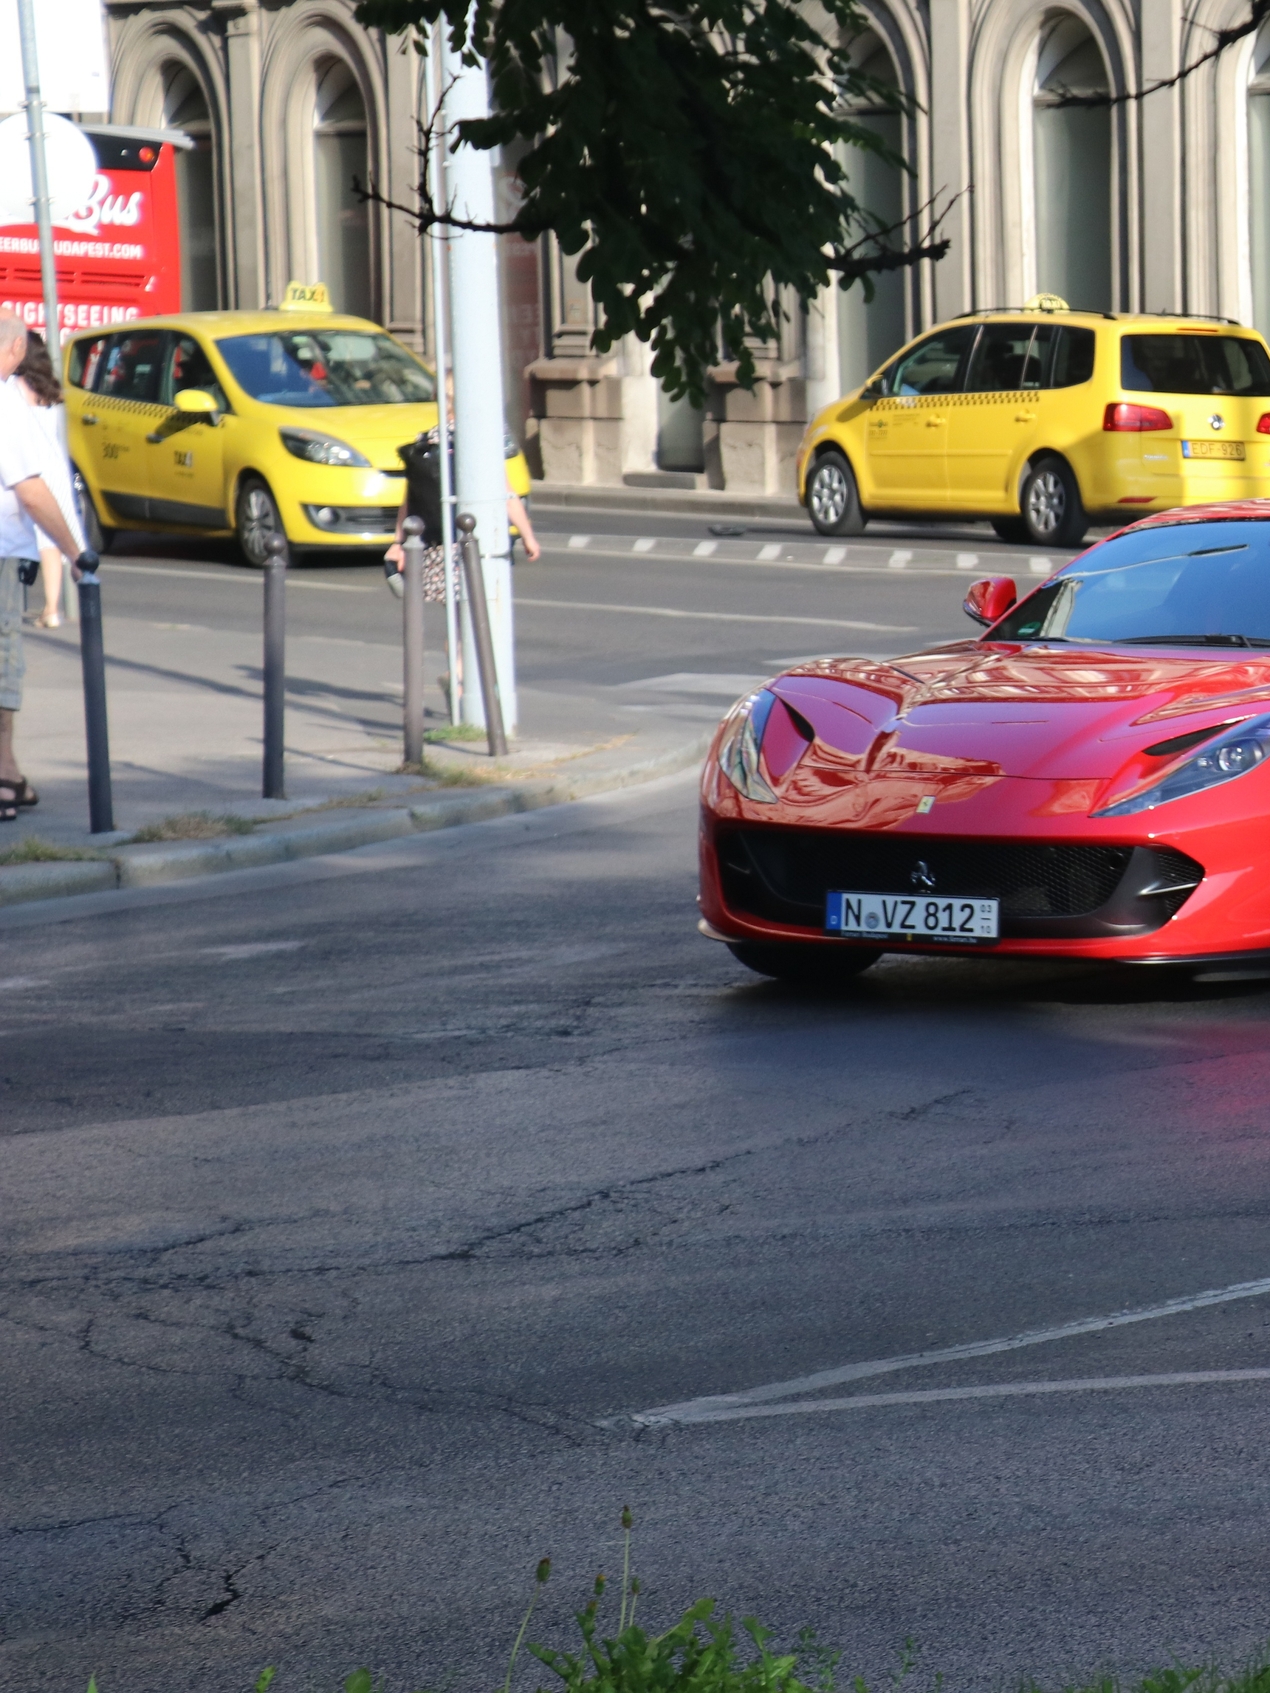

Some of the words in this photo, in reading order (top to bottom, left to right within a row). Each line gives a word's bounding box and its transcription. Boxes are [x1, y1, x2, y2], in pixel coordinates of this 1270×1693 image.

[0, 236, 142, 259] EERBUUDAPEST.COM
[1191, 442, 1242, 456] EDF-926
[845, 898, 862, 927] N
[882, 900, 916, 929] VZ
[924, 902, 975, 932] 812
